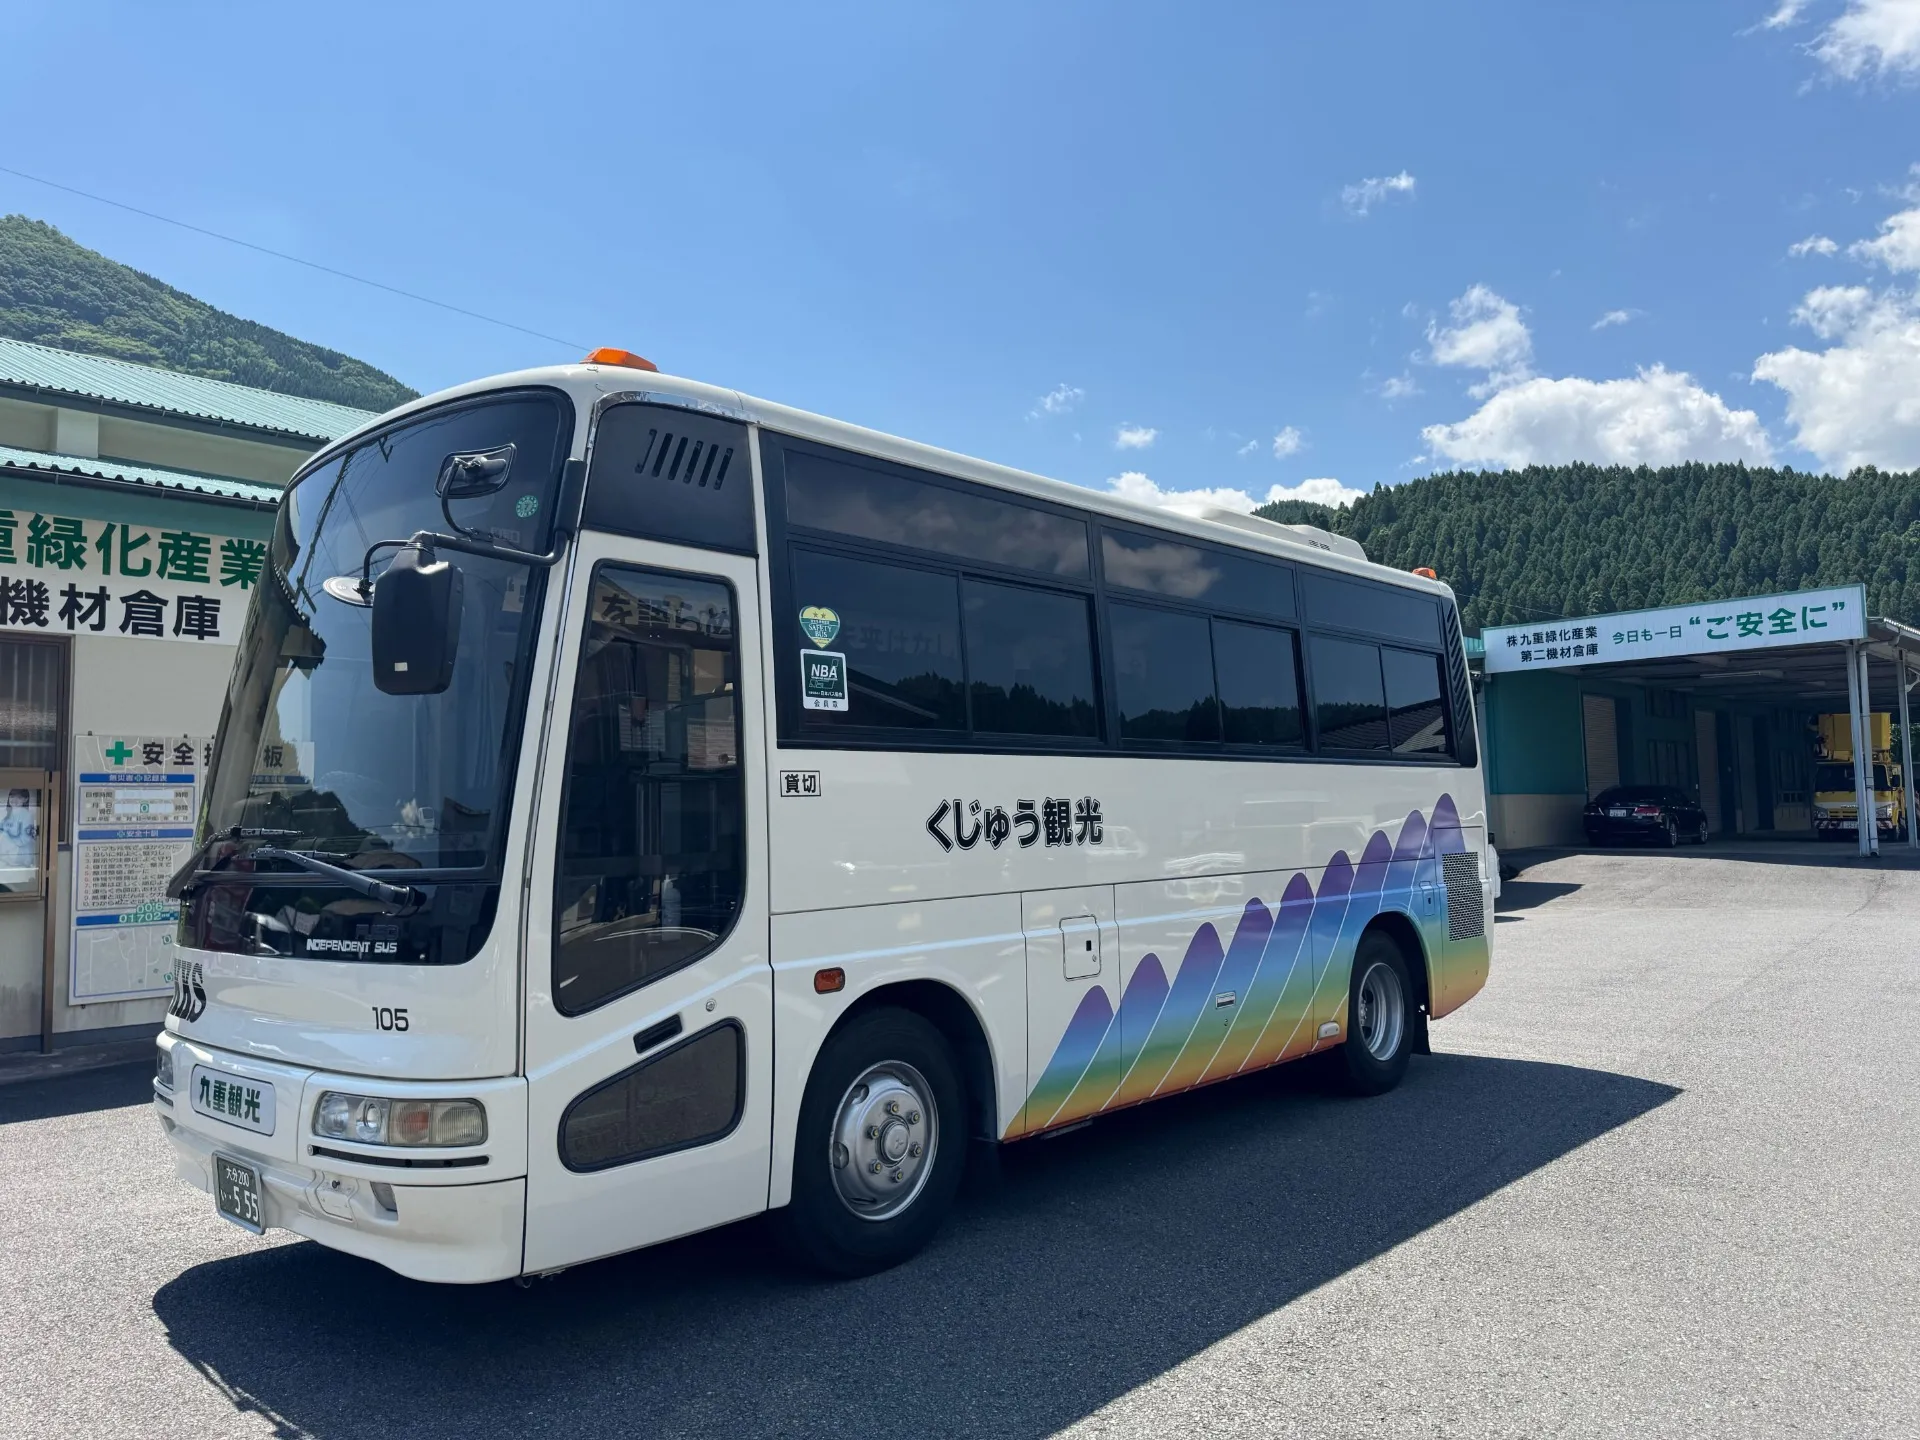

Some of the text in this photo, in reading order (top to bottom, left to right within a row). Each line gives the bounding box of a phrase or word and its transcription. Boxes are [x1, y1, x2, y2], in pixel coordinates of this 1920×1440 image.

[0, 576, 221, 640] 機材倉庫
[808, 624, 832, 633] SAFETY
[1612, 625, 1682, 645] 今日も一日
[1520, 643, 1599, 663] 第二機材倉庫
[811, 663, 838, 679] NBA
[784, 773, 817, 794] 貸切
[926, 796, 1105, 853] くじゅう観光
[306, 938, 370, 953] INDEPENDENT
[372, 1006, 409, 1032] 105
[199, 1075, 261, 1124] 九重観光
